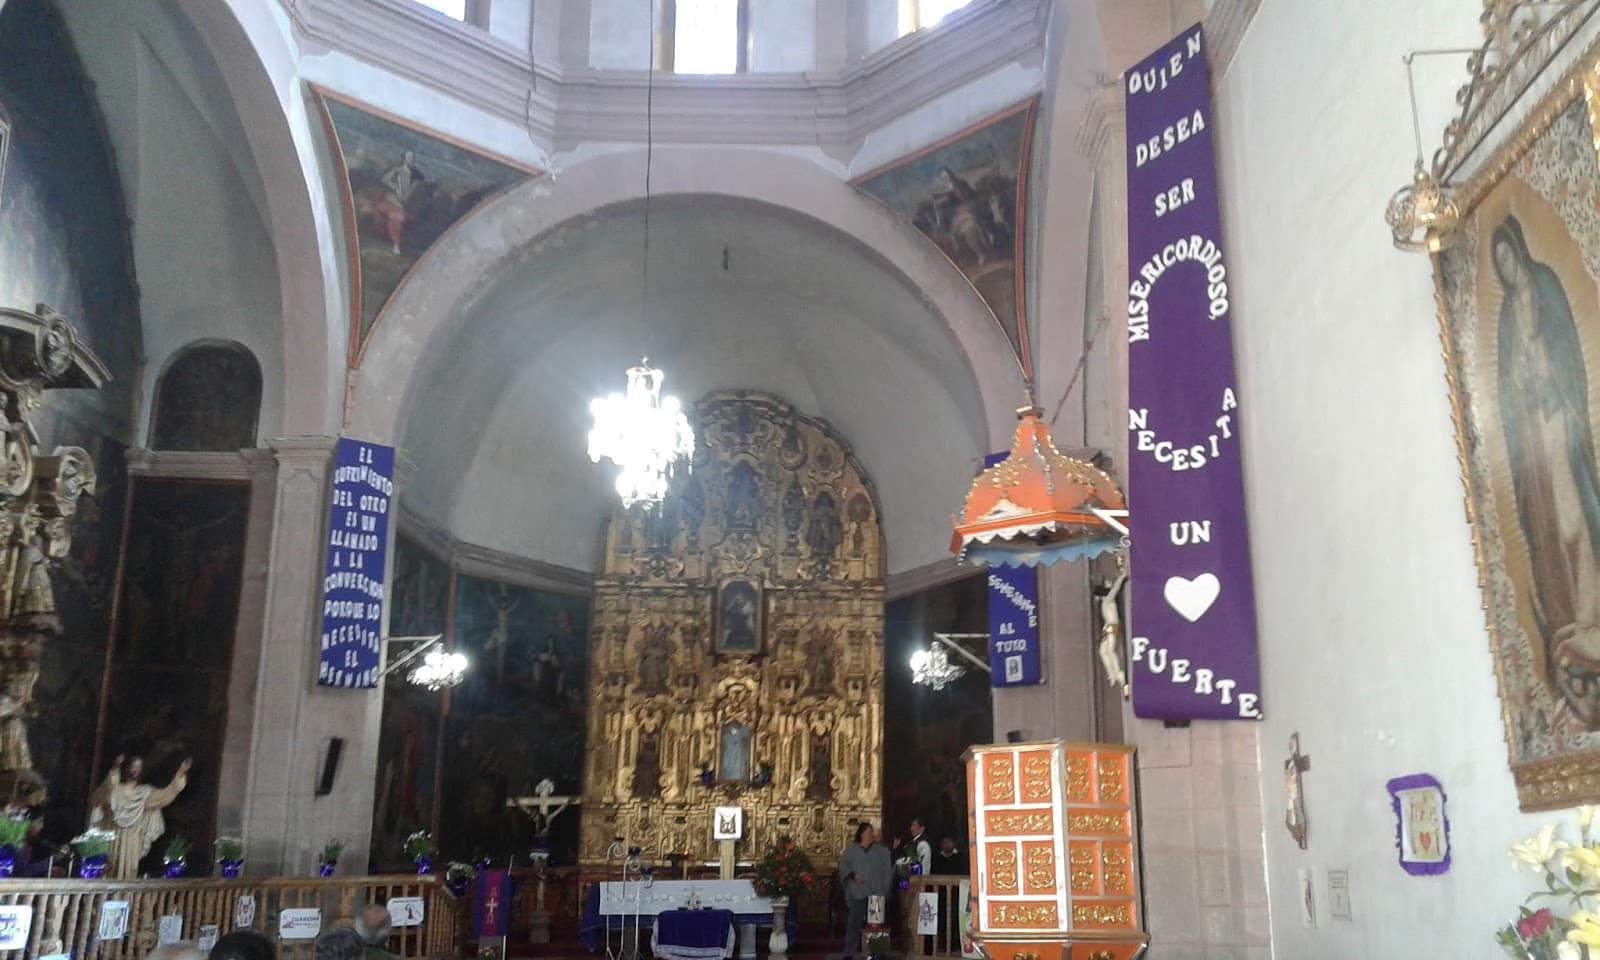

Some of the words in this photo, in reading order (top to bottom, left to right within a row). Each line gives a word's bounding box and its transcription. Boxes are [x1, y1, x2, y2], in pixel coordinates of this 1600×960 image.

[1135, 109, 1206, 168] DESEA
[1154, 177, 1195, 217] SER
[1129, 386, 1237, 471] NECESITA
[359, 446, 373, 464] EL
[333, 489, 353, 507] DEL
[360, 495, 387, 514] OTRO
[346, 511, 357, 527] ES
[361, 515, 376, 532] UN
[1170, 520, 1211, 546] UN
[330, 529, 378, 551] LLAMADO
[333, 551, 340, 567] A
[349, 551, 363, 569] LA
[324, 600, 364, 619] PORQUE
[367, 603, 380, 620] LO
[988, 574, 1037, 628] SEMEJANTE
[321, 624, 378, 652] NECESITA
[999, 622, 1015, 635] AL
[345, 650, 358, 668] EL
